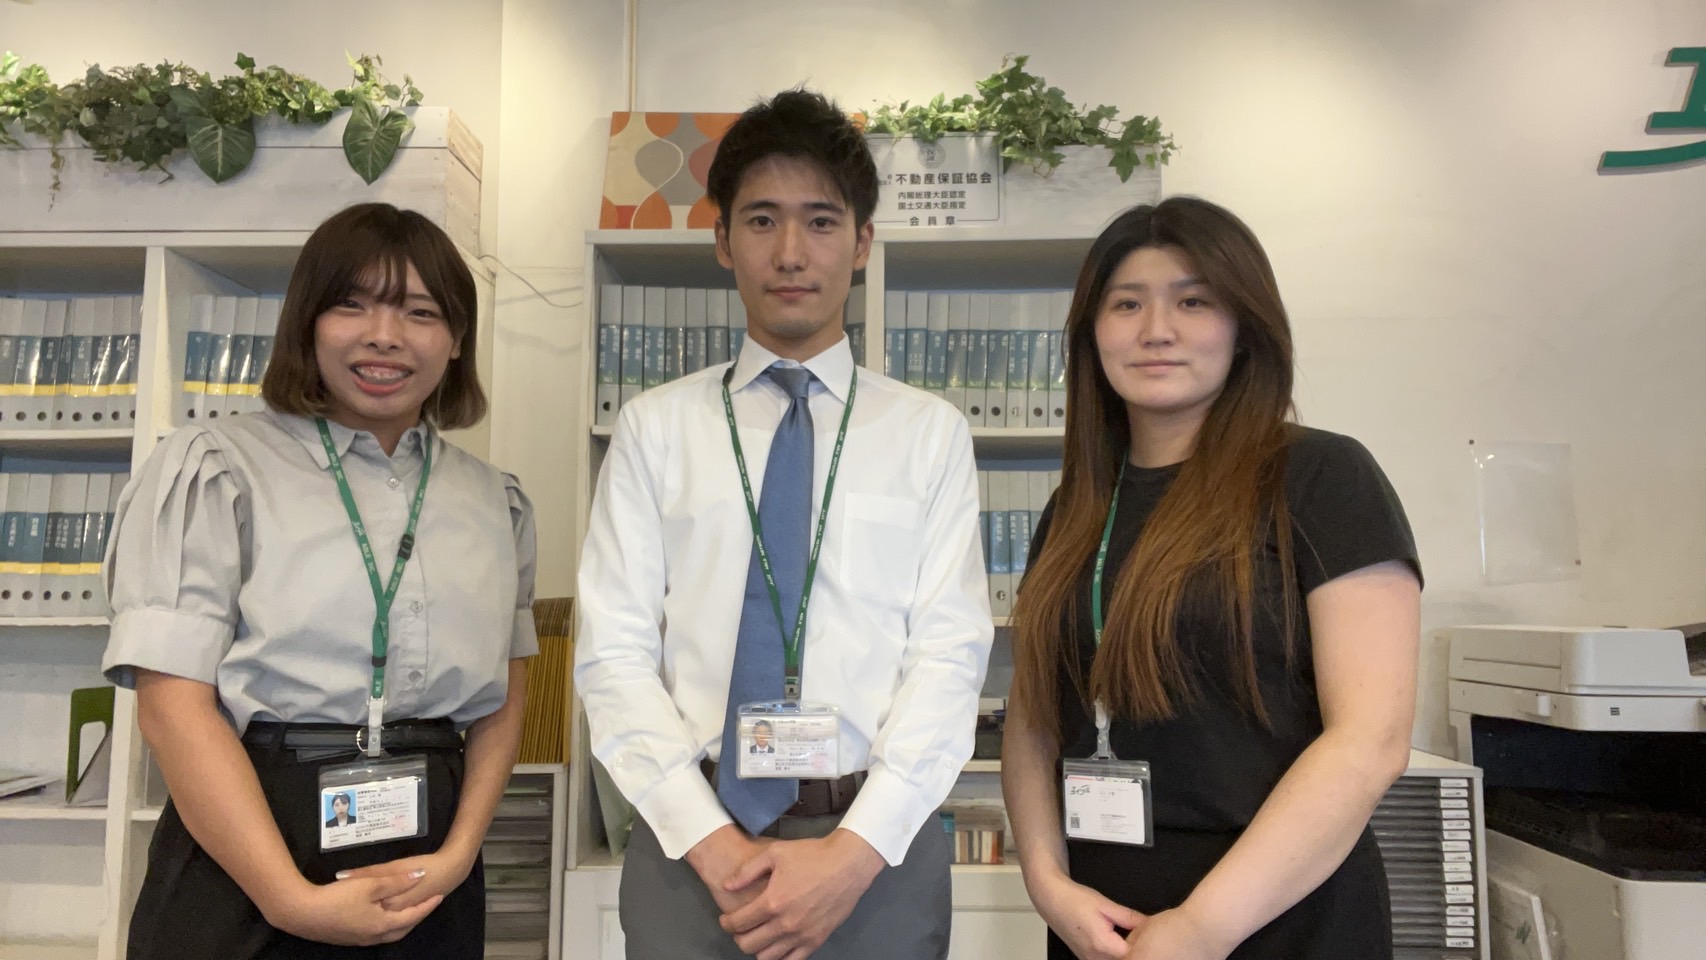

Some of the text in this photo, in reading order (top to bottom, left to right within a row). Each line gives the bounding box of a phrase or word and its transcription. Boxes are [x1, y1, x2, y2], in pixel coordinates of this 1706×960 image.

[895, 172, 992, 185] 不動産保証協会
